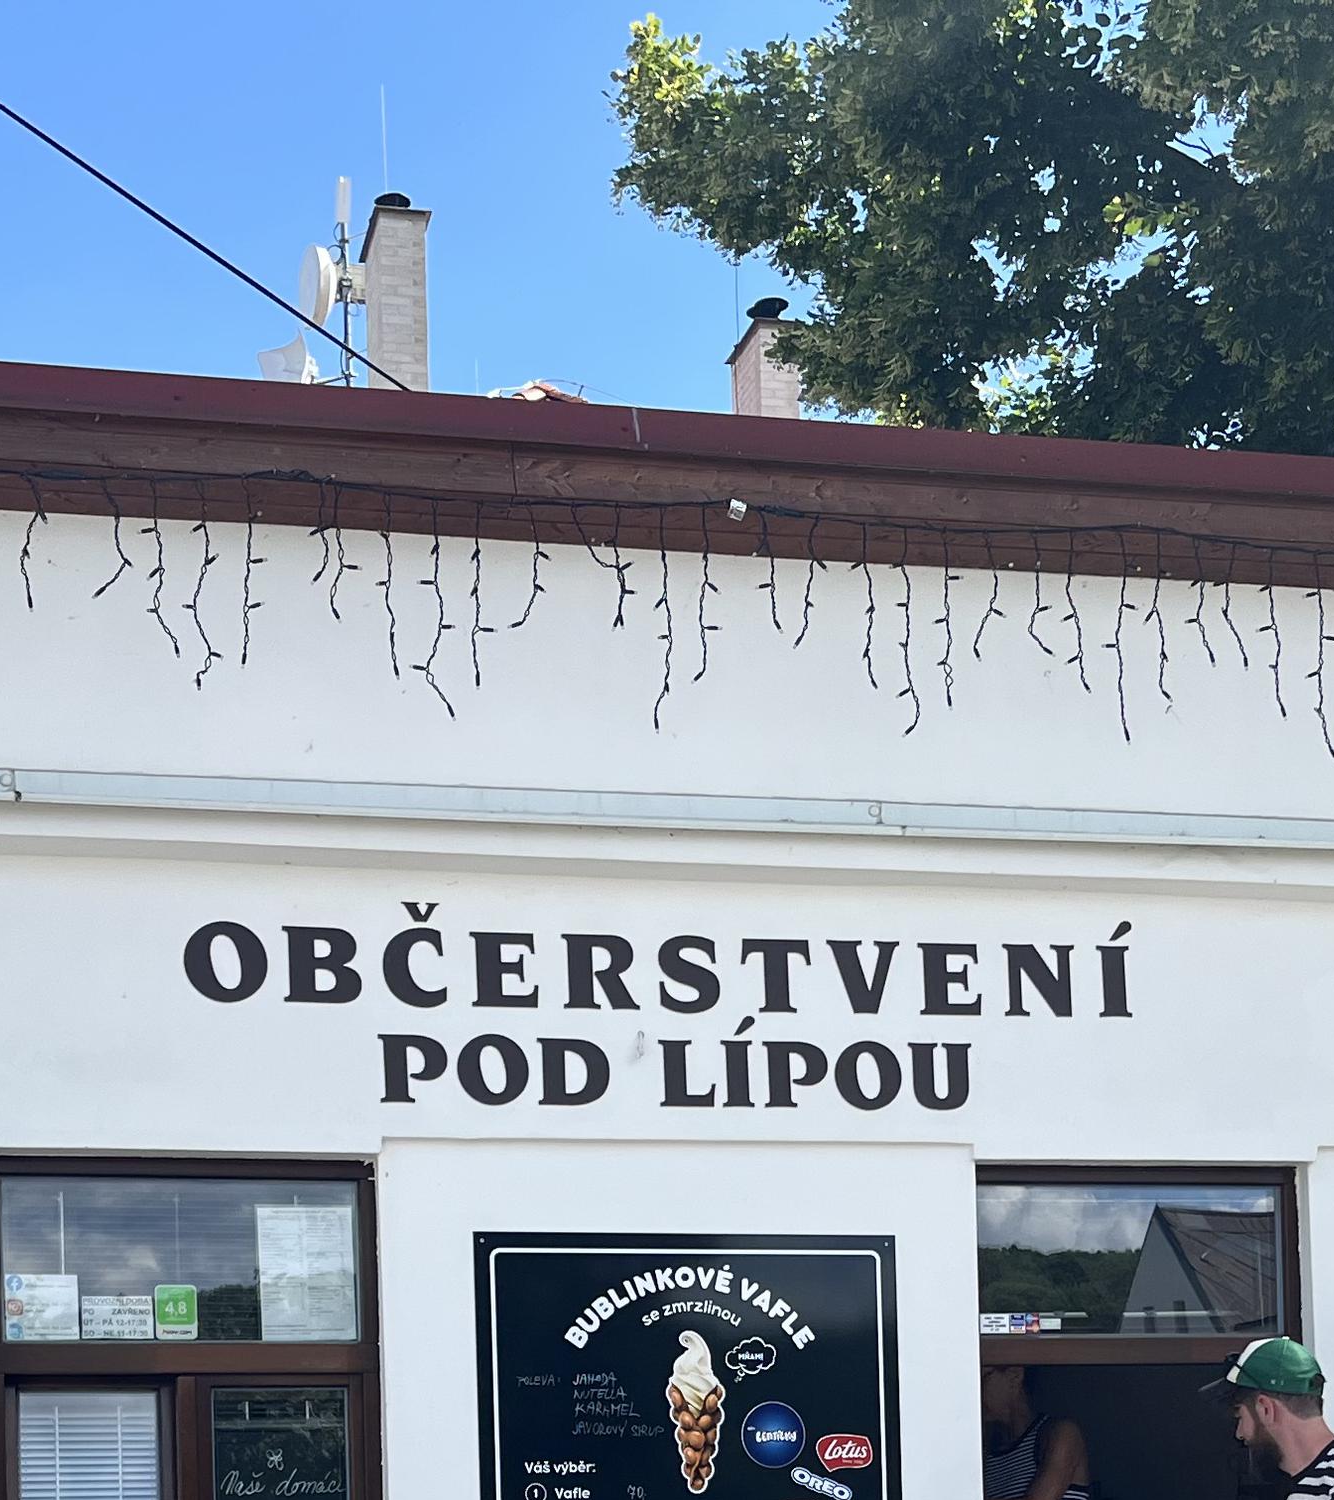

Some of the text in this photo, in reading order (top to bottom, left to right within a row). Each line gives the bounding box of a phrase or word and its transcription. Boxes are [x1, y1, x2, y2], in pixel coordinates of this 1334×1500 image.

[183, 902, 1133, 1018] OBČERSTVENÍ
[376, 1015, 972, 1109] POD LÍPOU
[564, 1264, 815, 1350] BUBLINKOVÉ VAFLE
[641, 1300, 742, 1327] se zmrzlinou
[572, 1372, 617, 1387] JAHODA
[824, 1439, 868, 1460] Lotus
[525, 1461, 596, 1475] Váš výběr:
[220, 1470, 266, 1496] Naše
[555, 1488, 590, 1499] Vafle
[793, 1469, 850, 1500] OREO
